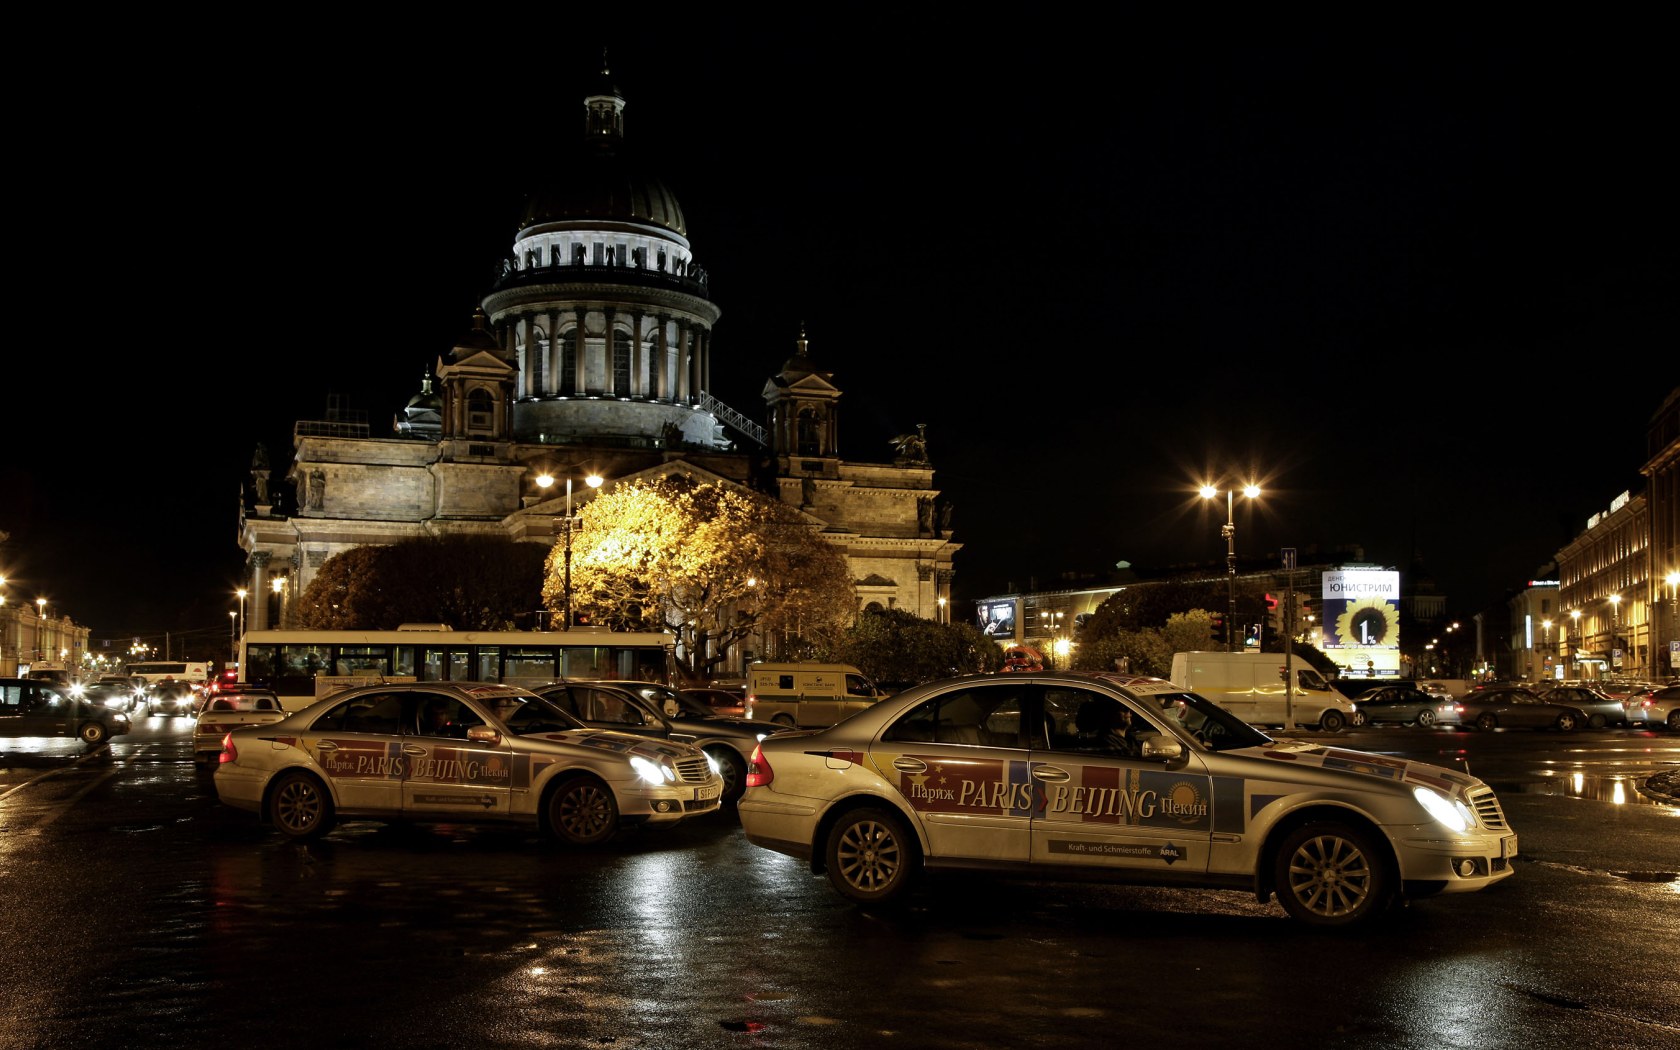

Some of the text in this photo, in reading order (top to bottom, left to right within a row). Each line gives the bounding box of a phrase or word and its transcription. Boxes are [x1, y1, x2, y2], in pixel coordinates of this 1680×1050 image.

[1329, 583, 1393, 593] ЮНИСТРИМ
[1673, 642, 1680, 651] P
[326, 759, 354, 772] Париж
[356, 756, 478, 780] PARIS BEIJING
[480, 765, 509, 778] Пекин
[911, 783, 955, 803] Париж
[957, 779, 1157, 818] PARIS BEIJING
[1161, 797, 1208, 816] Пекин
[1068, 843, 1152, 856] Kraft- und Schmierstoffe
[1159, 848, 1179, 857] ARAL
